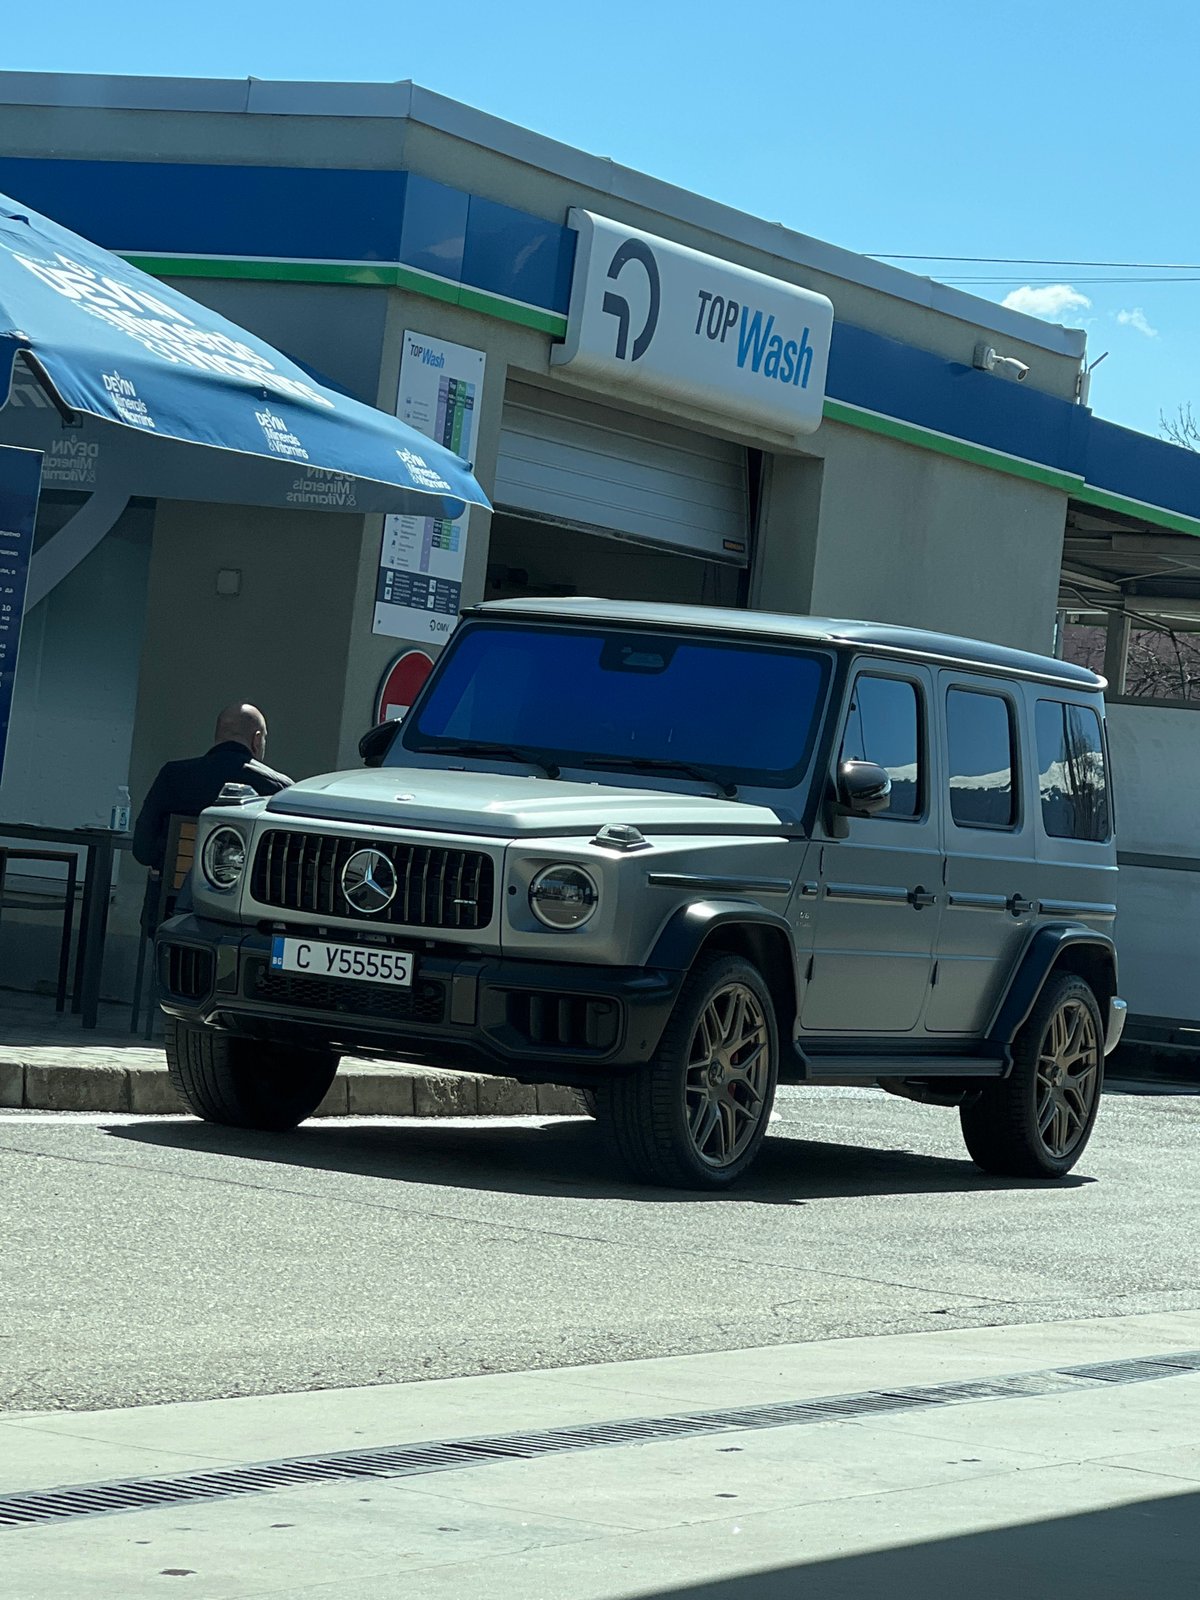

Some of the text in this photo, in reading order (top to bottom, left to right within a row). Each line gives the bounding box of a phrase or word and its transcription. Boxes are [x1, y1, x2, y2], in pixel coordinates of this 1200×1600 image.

[12, 254, 195, 326] DEVIN
[102, 373, 136, 397] DEVIN
[111, 392, 147, 414] Minerals
[255, 411, 288, 432] DEVIN
[265, 427, 301, 446] Minerals
[396, 450, 427, 468] DEVIN
[407, 463, 441, 479] Minerals
[2, 604, 12, 612] 10
[272, 956, 282, 965] BG
